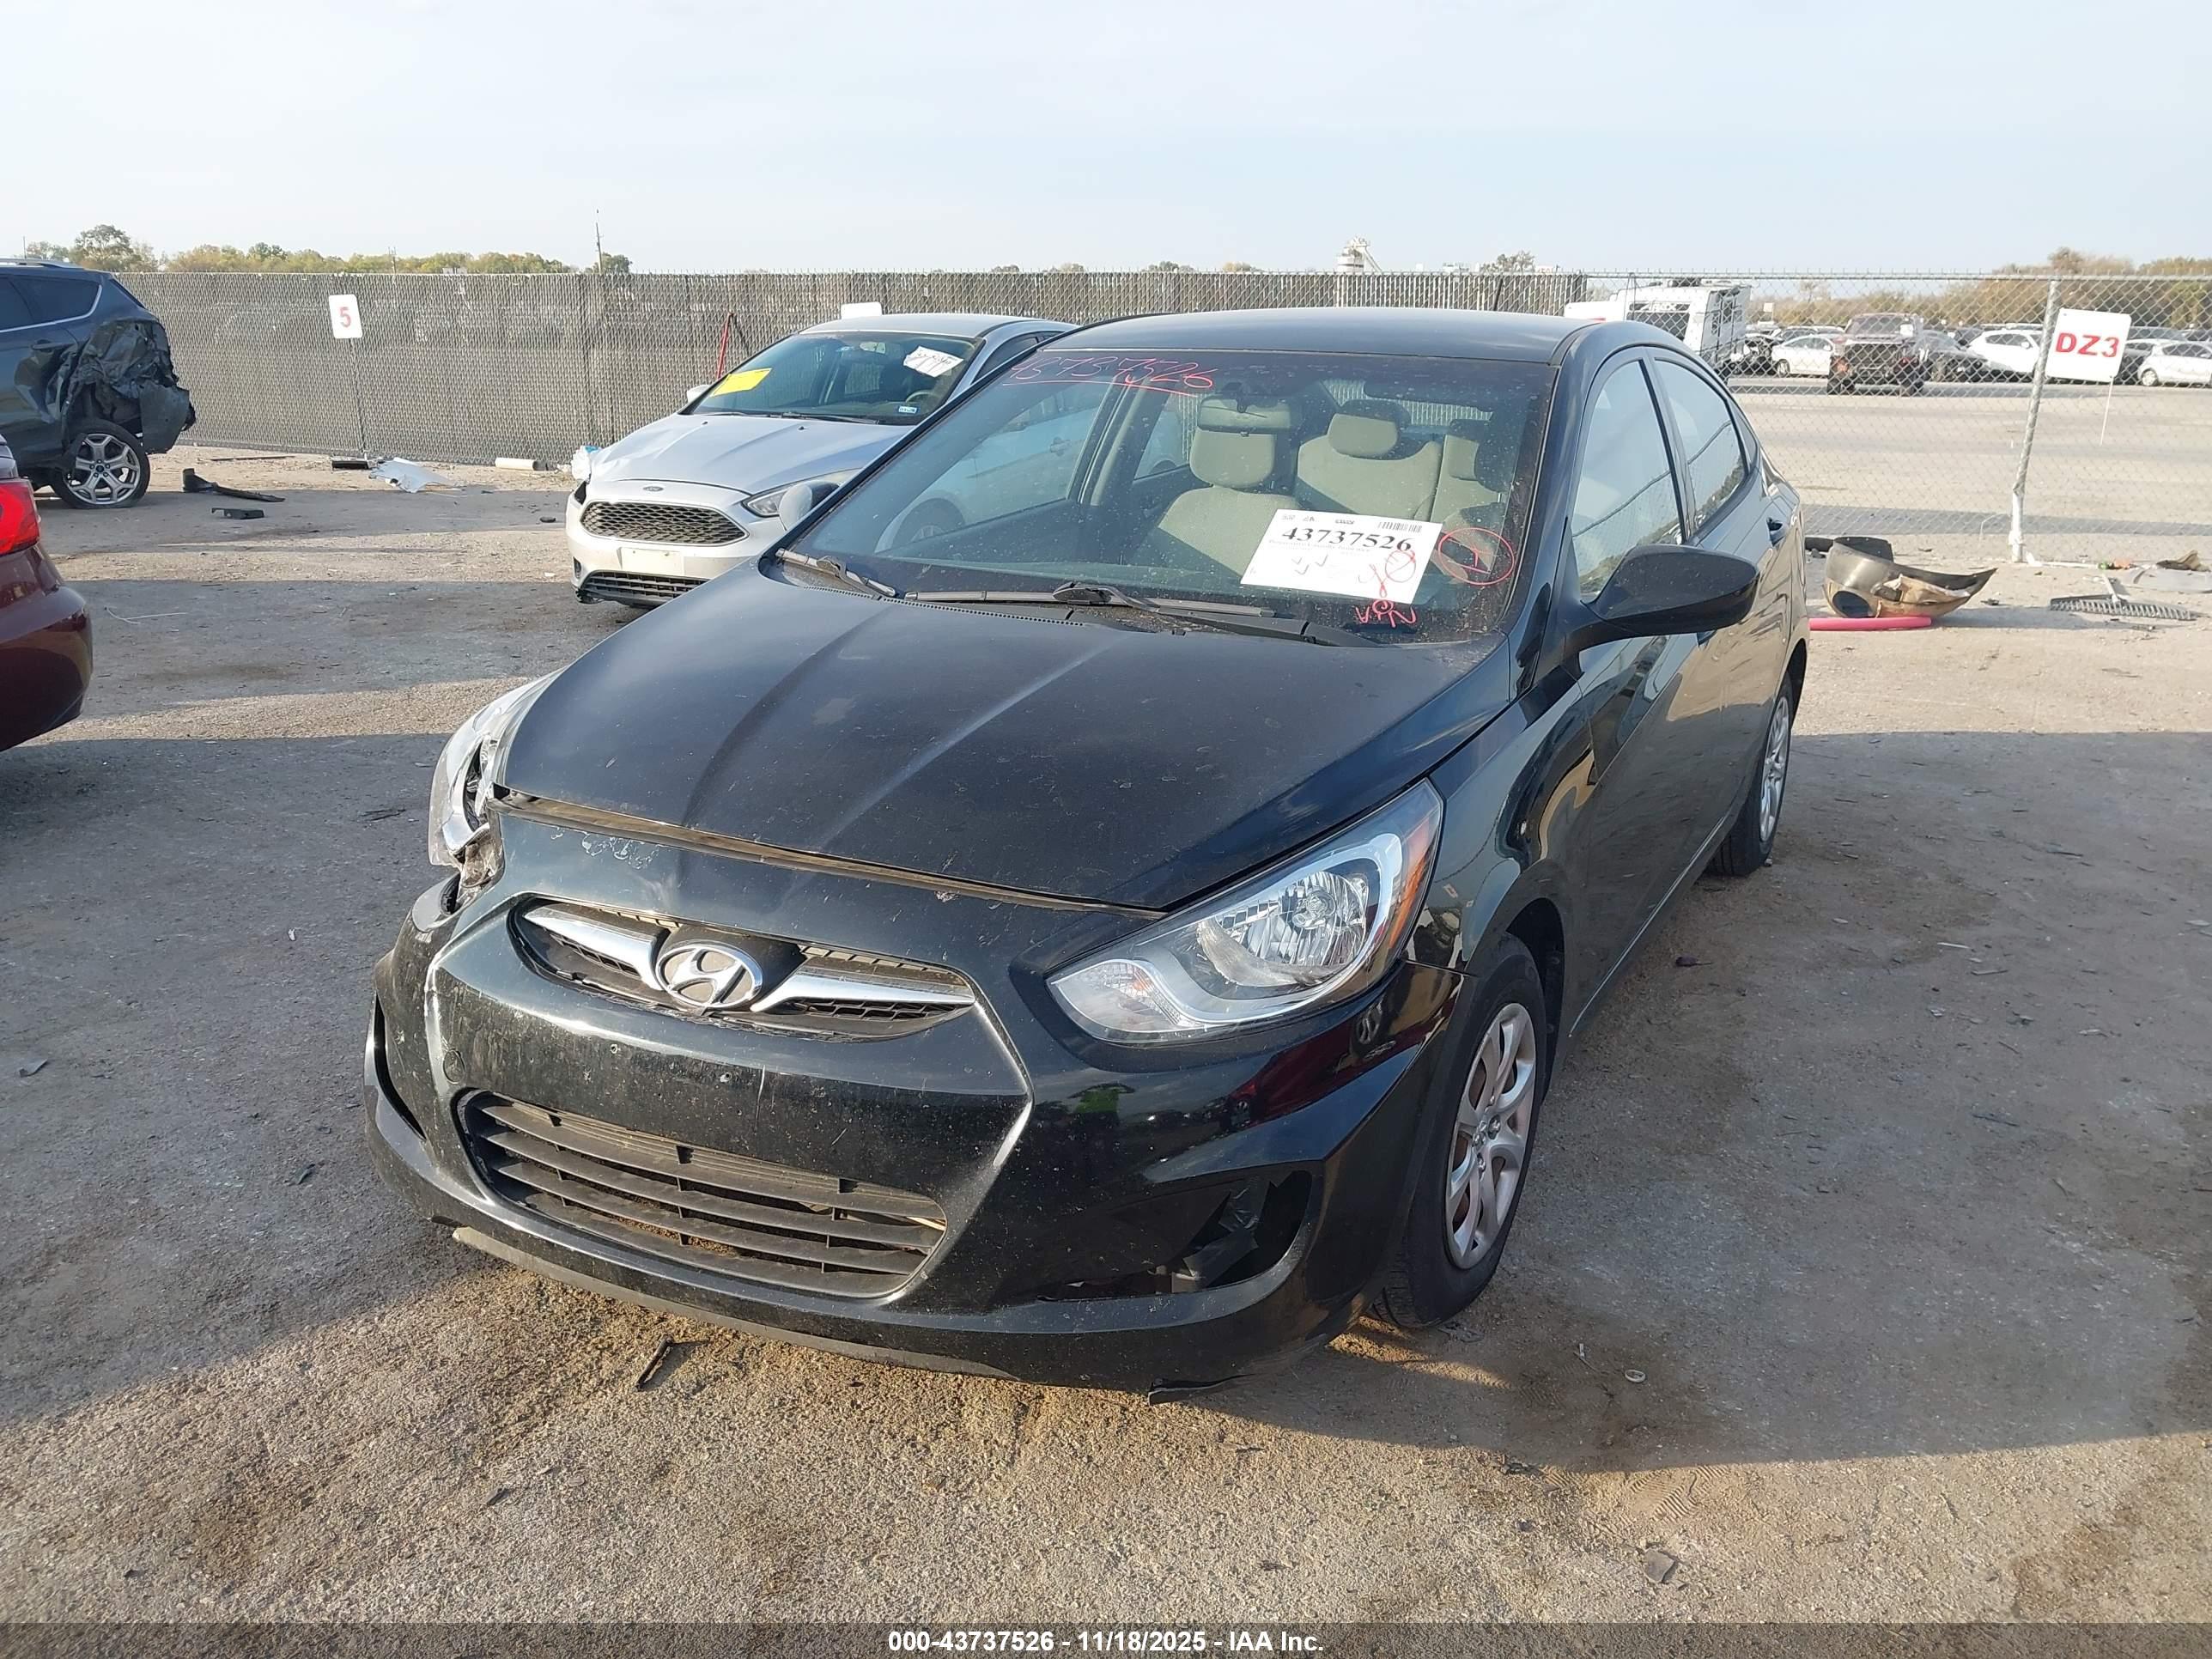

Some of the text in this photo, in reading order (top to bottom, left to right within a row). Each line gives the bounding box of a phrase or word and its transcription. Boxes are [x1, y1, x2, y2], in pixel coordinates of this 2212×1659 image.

[339, 306, 351, 327] 5
[2055, 332, 2120, 358] DZ3
[1281, 526, 1416, 552] 43737526
